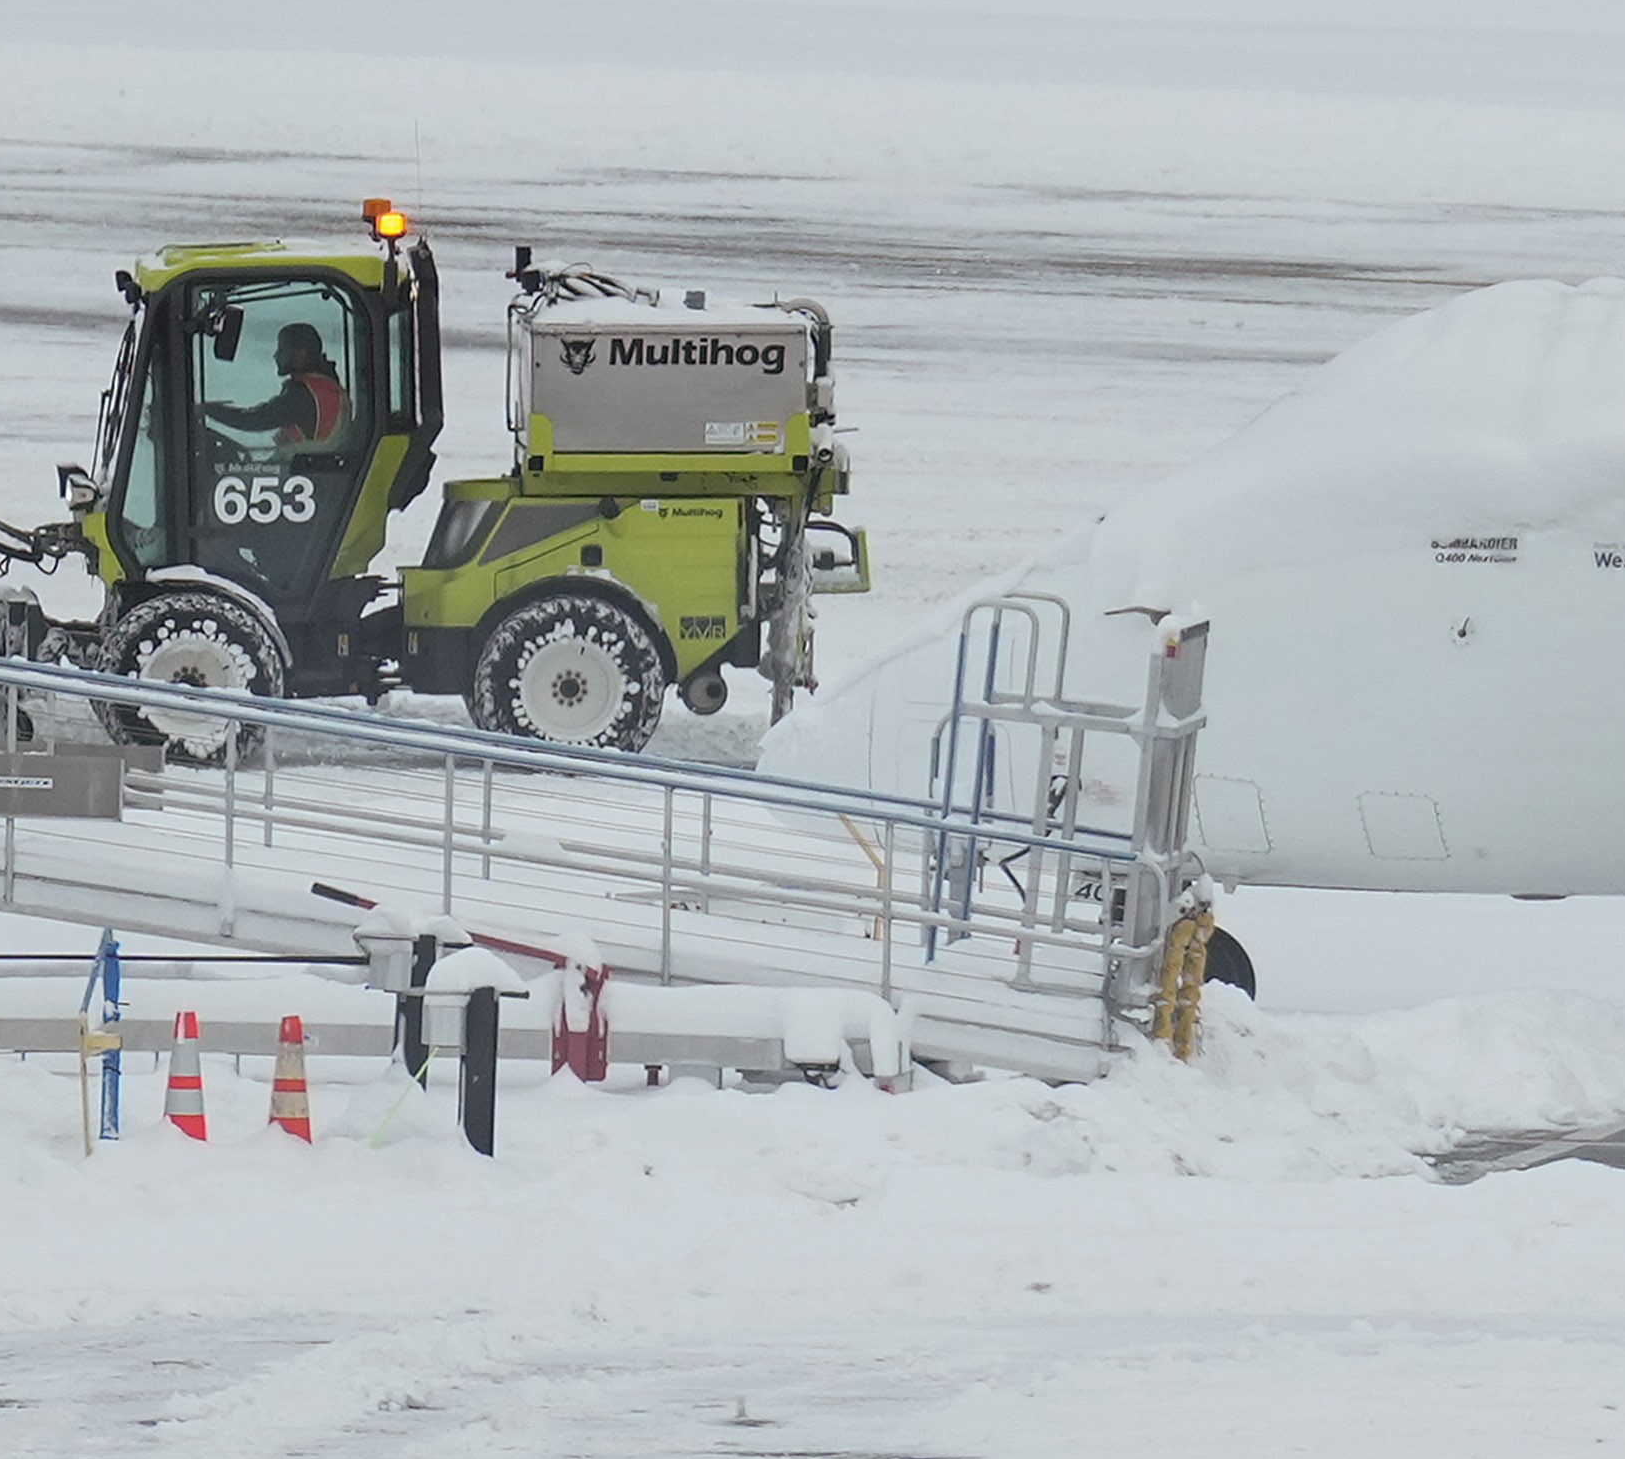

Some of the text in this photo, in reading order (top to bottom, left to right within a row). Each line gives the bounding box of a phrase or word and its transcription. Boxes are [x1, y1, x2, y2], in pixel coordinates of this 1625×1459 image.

[609, 338, 786, 375] Multihog
[214, 475, 316, 524] 653
[672, 507, 724, 519] Multihog
[1435, 552, 1466, 563] Q400
